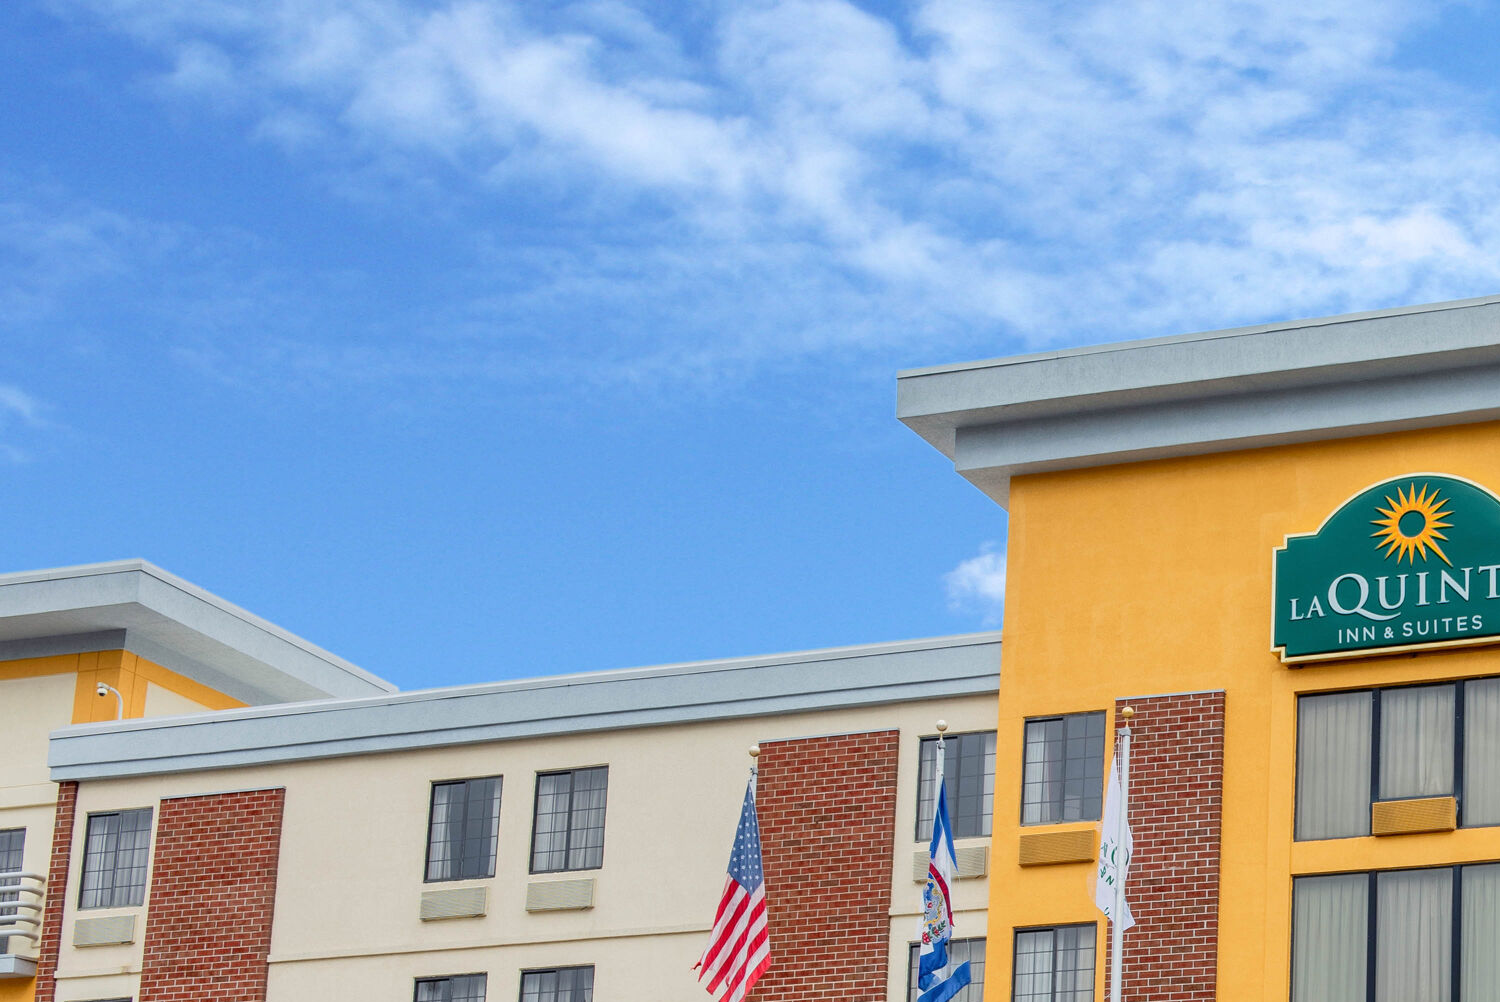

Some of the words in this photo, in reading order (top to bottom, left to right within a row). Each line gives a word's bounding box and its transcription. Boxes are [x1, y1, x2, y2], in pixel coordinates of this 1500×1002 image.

[1289, 595, 1327, 621] LA
[1338, 626, 1376, 644] INN
[1383, 626, 1394, 639] &
[1402, 615, 1483, 637] SUITES
